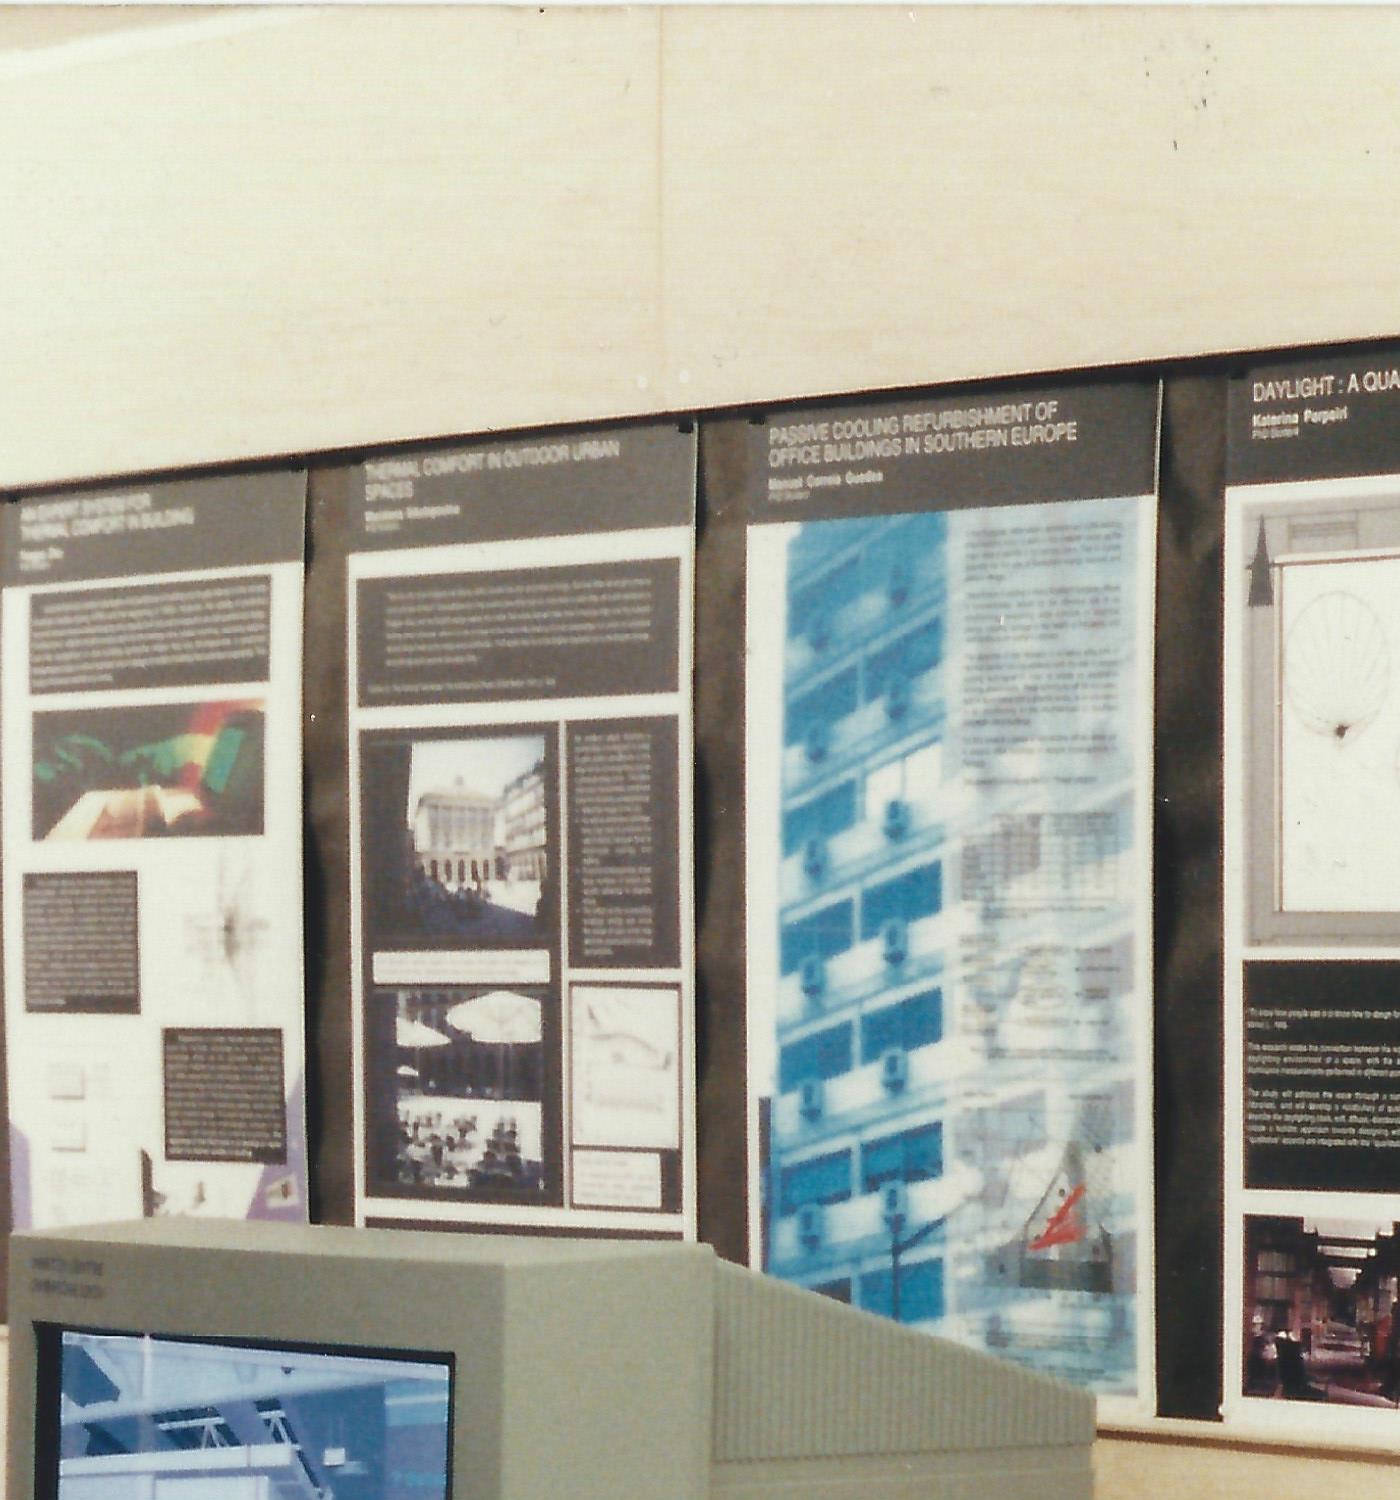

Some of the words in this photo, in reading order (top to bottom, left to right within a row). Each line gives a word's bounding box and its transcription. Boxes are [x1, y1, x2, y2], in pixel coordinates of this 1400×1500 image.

[1253, 375, 1335, 402] DAYLIGHT
[1347, 373, 1360, 393] A
[768, 444, 821, 468] OFFICE
[823, 437, 902, 463] BUILDINGS
[904, 436, 921, 454] IN
[923, 428, 1007, 454] SOUTHERN
[1010, 421, 1078, 447] EUROPE
[769, 422, 833, 447] PASSIVE
[833, 416, 899, 439] COOLING
[902, 402, 1033, 433] REFURBISHMENT
[1034, 400, 1059, 420] OF
[422, 452, 485, 477] COMFORT
[487, 451, 502, 470] IN
[503, 444, 570, 469] OUTDOOR
[572, 440, 620, 462] URBAN
